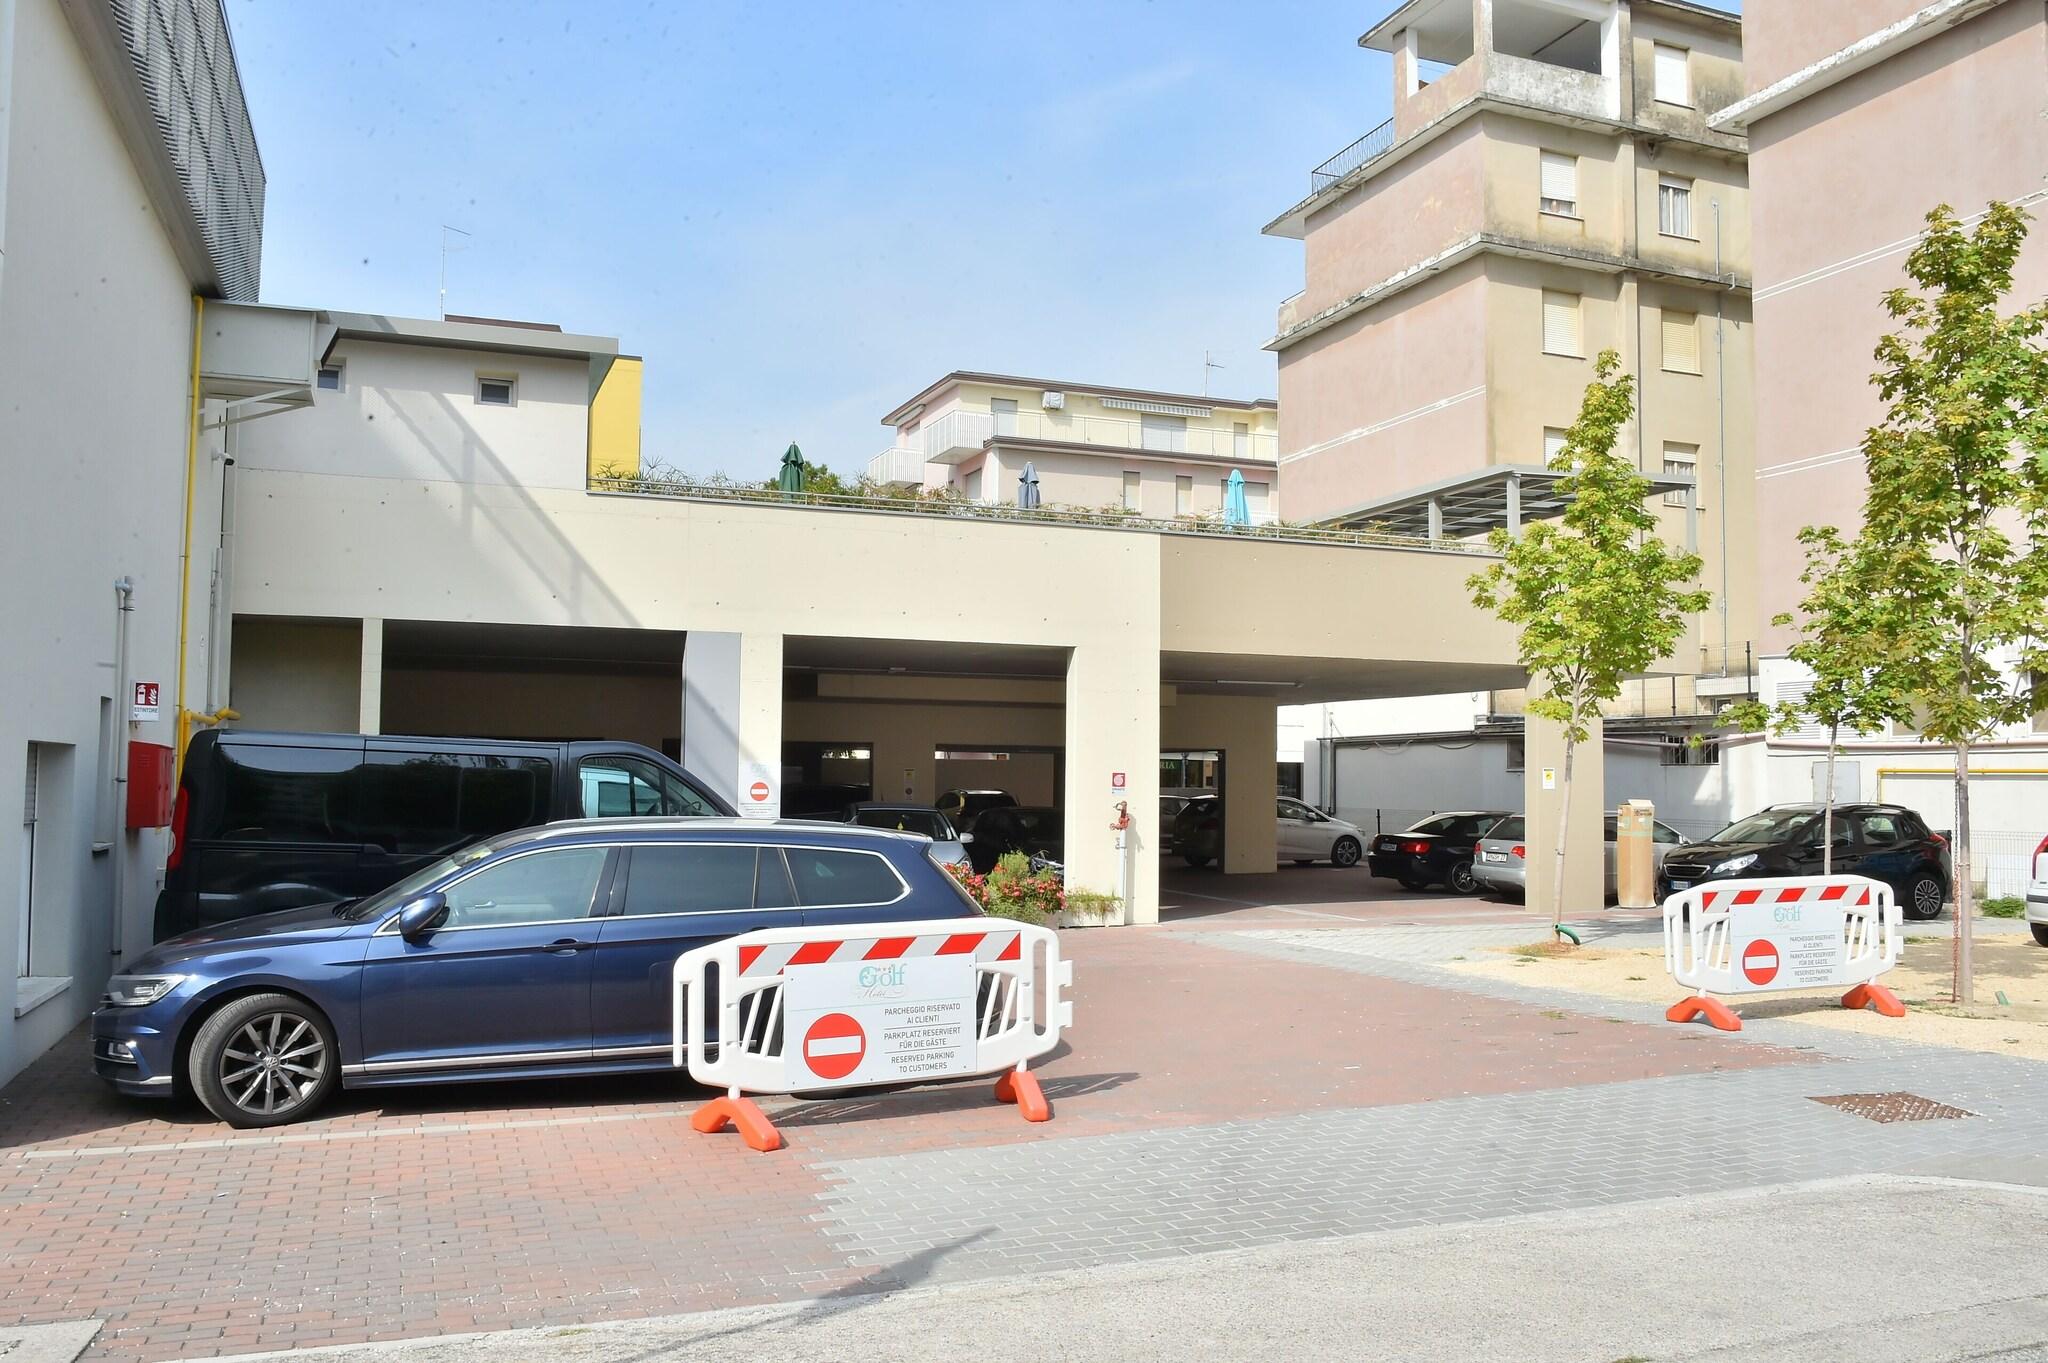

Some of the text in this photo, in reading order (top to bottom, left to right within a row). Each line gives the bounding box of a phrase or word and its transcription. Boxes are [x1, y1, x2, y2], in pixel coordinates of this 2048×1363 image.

[859, 963, 907, 988] Golf
[884, 1002, 961, 1016] PARCHEGGIO RISERVATO
[906, 1013, 940, 1025] AI CLIENTI
[884, 1027, 961, 1041] PARKPLATZ RESERVIERT
[899, 1037, 947, 1050] FÜR DIE GÄSTE
[891, 1050, 955, 1065] RESERVED PARKING
[899, 1061, 948, 1074] TO CUSTOMERS
